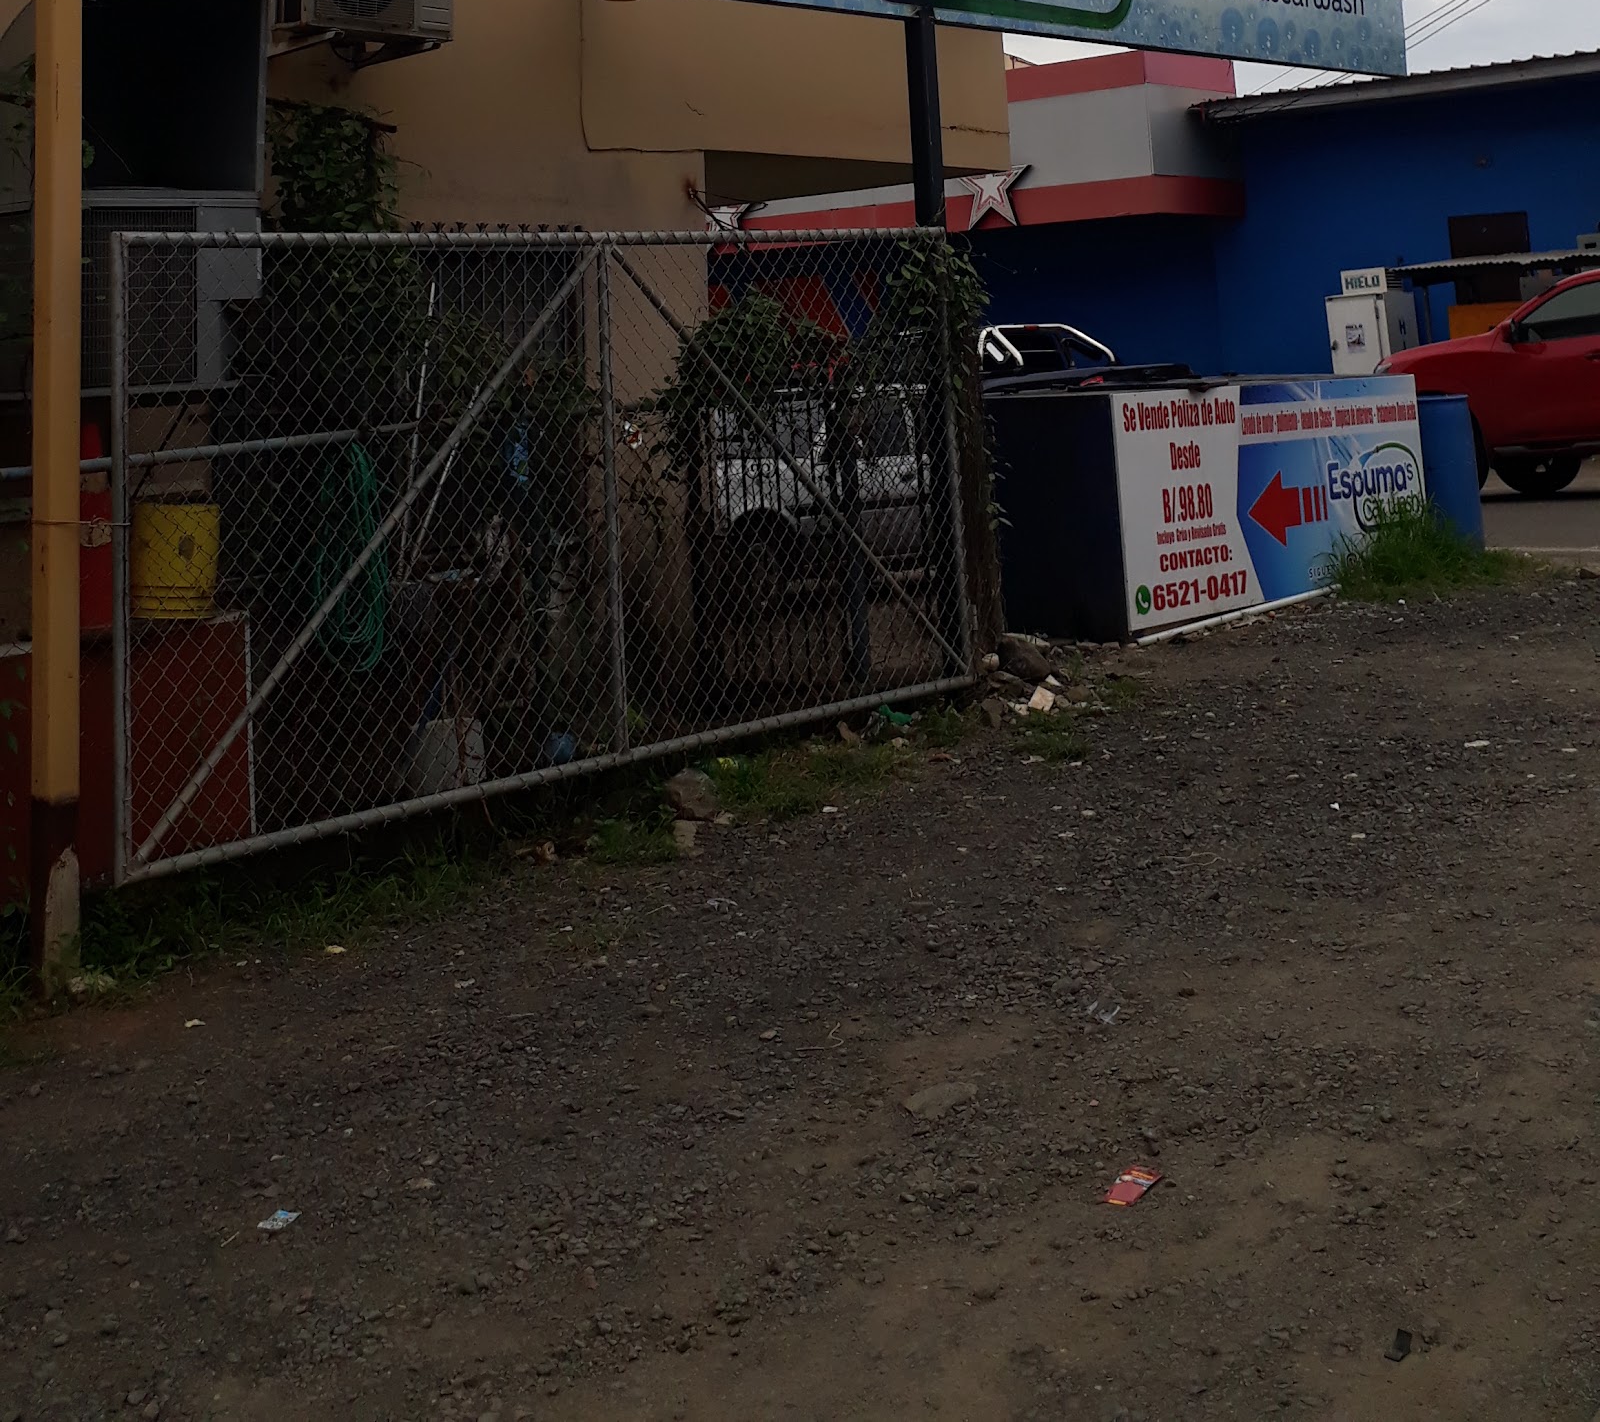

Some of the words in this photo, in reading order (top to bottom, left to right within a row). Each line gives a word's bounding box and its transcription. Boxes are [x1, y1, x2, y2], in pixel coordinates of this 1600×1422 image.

[1345, 275, 1380, 290] HIELO
[1122, 402, 1137, 432] Se
[1137, 400, 1170, 430] Vende
[1171, 398, 1200, 428] Póliza
[1201, 398, 1213, 426] de
[1214, 397, 1236, 425] Auto
[1170, 440, 1201, 470] Desde
[1327, 461, 1414, 500] Espuma's
[1160, 544, 1232, 572] CONTACTO:
[1152, 570, 1247, 610] 6521-0417
